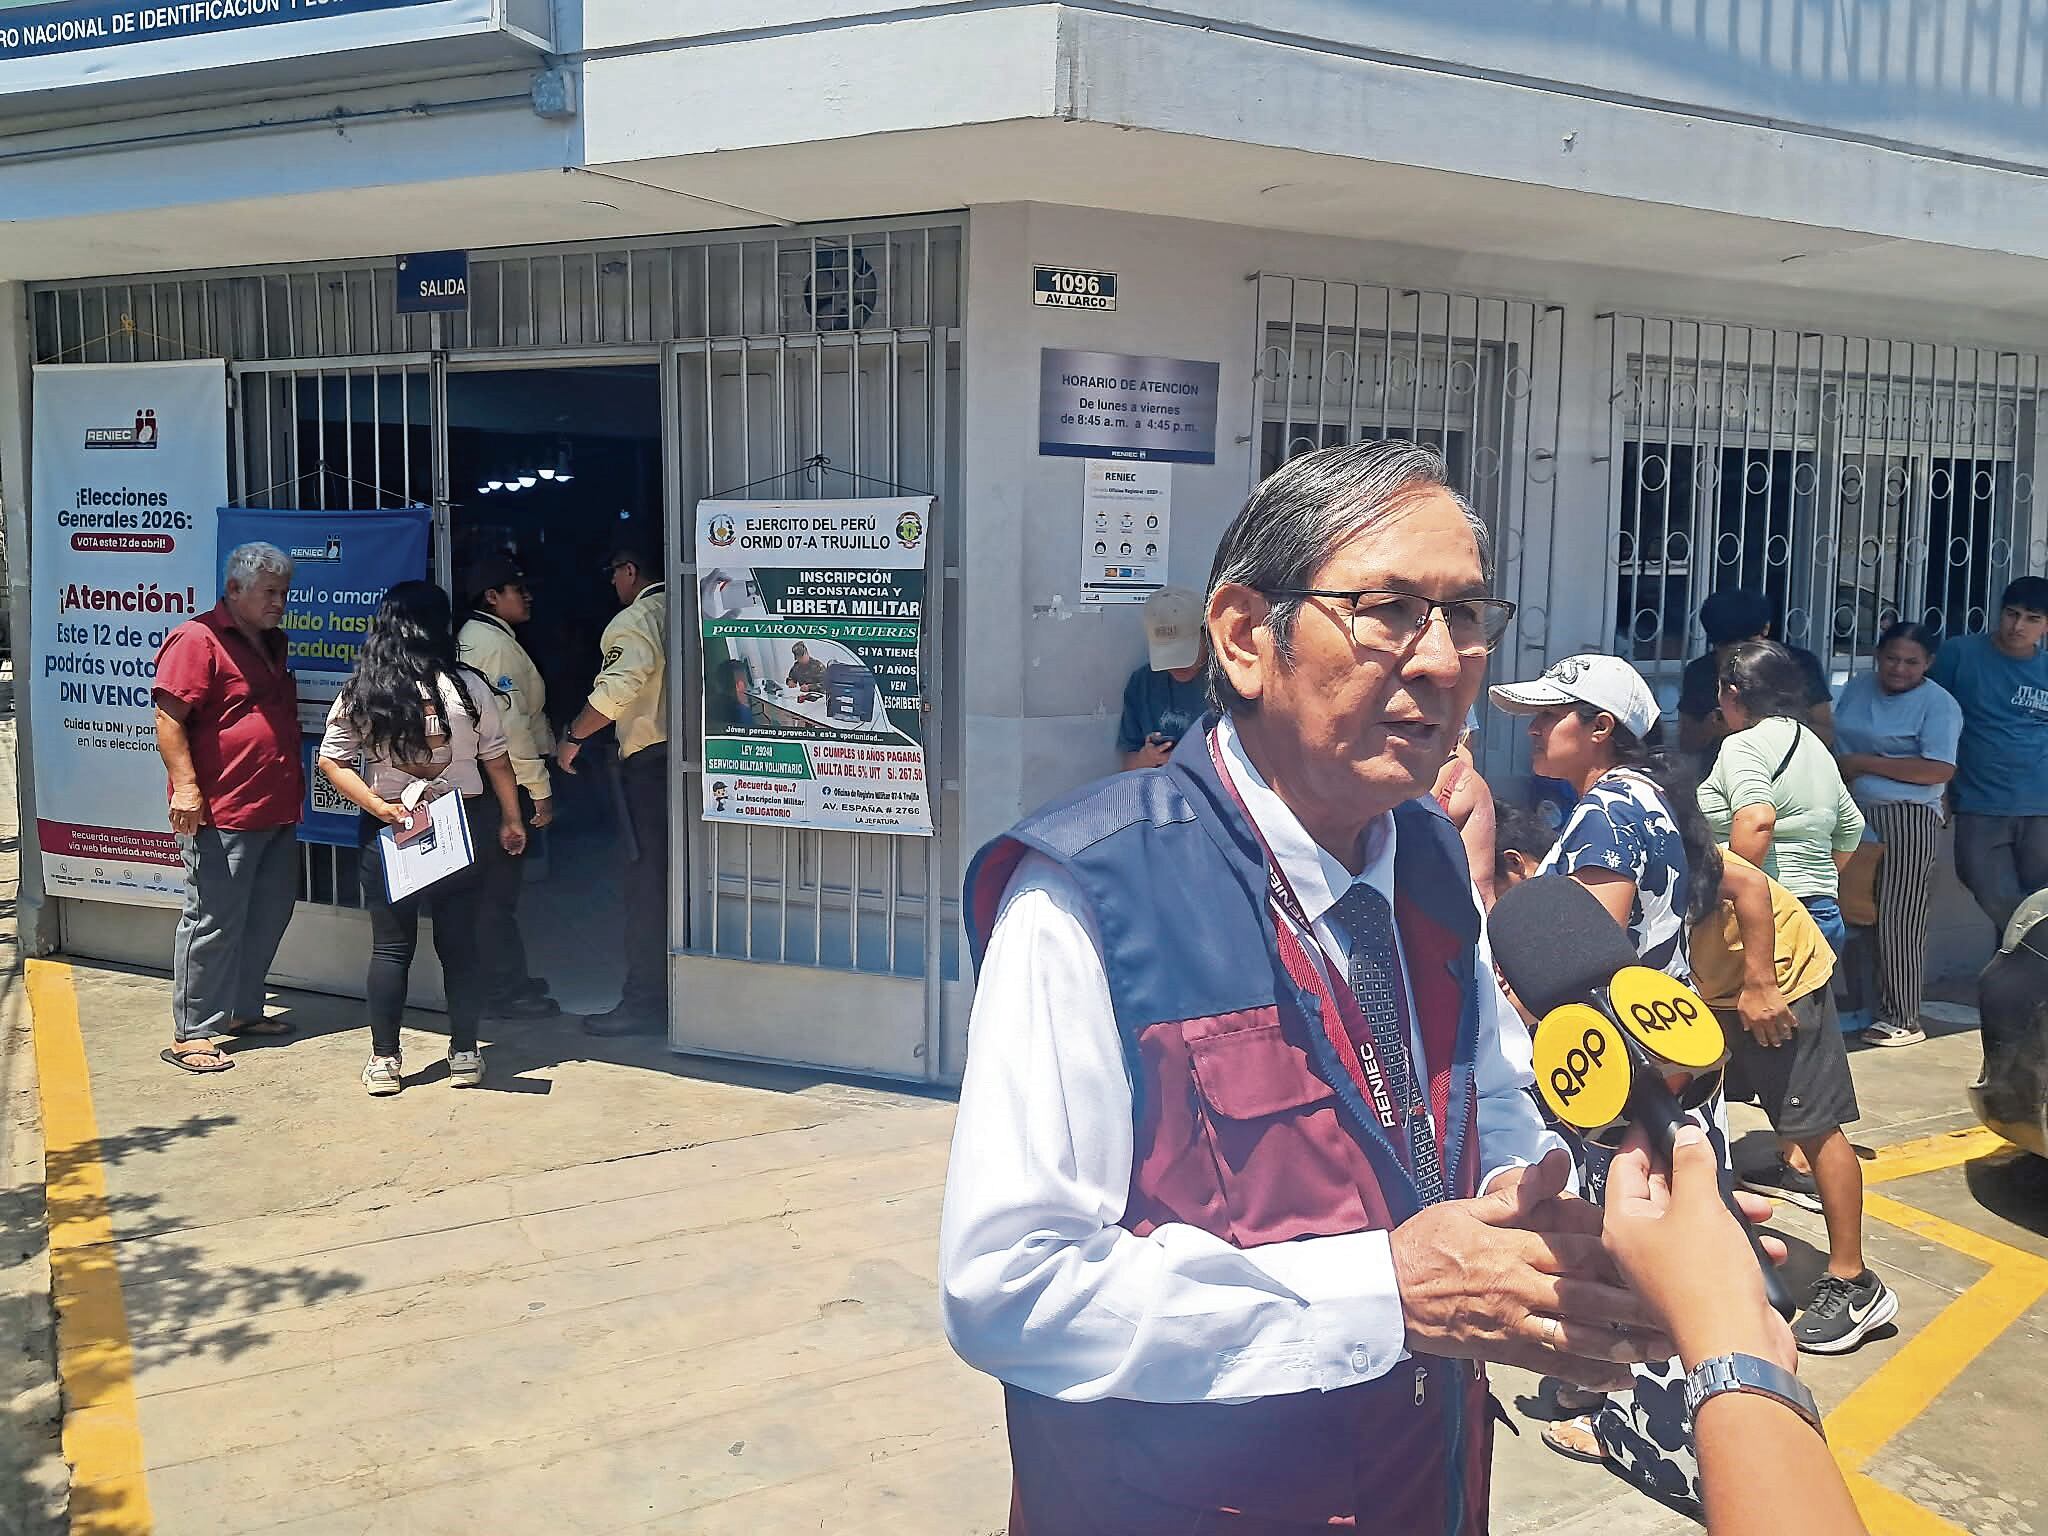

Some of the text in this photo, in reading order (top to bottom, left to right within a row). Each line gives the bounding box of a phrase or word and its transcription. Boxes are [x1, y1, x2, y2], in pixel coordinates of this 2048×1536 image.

[23, 17, 108, 46] NACIONAL
[112, 12, 136, 34] DE
[420, 278, 466, 297] SALIDA
[1051, 272, 1100, 294] 1096
[1046, 293, 1107, 307] AV. LARCO
[1062, 375, 1117, 389] HORARIO
[1120, 379, 1137, 391] DE
[1079, 397, 1180, 415] De lunes a viernes
[1060, 413, 1075, 424] de
[1077, 414, 1101, 426] 8:45
[1134, 420, 1142, 429] a
[1147, 419, 1170, 431] 4:45
[87, 430, 132, 441] RENIEC
[1111, 450, 1139, 458] RENIEC
[1105, 472, 1137, 482] RENIEC
[76, 486, 168, 509] ¡Elecciones
[57, 510, 193, 530] Generales 2026:
[746, 514, 876, 531] EJERCITO DEL PERÚ
[77, 537, 166, 549] VOTA este 12 de abril!
[740, 535, 891, 550] ORMD 07-A TRUJILLO
[290, 548, 324, 557] RENIEC
[800, 569, 892, 584] INSCRIPCIÓN
[59, 583, 196, 614] ¡Atención!
[317, 591, 328, 603] o
[787, 586, 902, 597] DE CONSTANCIA Y
[776, 598, 920, 616] LIBRETA MILITAR
[57, 623, 169, 648] Este 12 de a
[713, 624, 917, 637] para VARONES y MUJERES
[858, 647, 920, 658] SI YA TIENES
[45, 652, 105, 677] podrás
[873, 663, 917, 675] 17 AÑOS
[60, 682, 87, 703] DNI
[890, 680, 907, 691] VEN
[63, 718, 90, 731] Cuida
[92, 720, 103, 732] tu
[105, 722, 124, 733] DNI
[126, 725, 133, 737] y
[749, 727, 776, 736] peruano
[77, 737, 90, 747] en
[92, 736, 107, 748] las
[741, 745, 753, 756] LEY
[813, 746, 921, 763] SI CUMPLES 18 AÑOS PAGARAS
[708, 759, 803, 774] SERVICIO MILITAR VOLUNTARIO
[817, 762, 842, 776] MULTA
[844, 764, 857, 777] DEL
[858, 765, 868, 778] 5%
[869, 766, 881, 779] UIT
[898, 767, 923, 781] 267.50
[733, 779, 797, 793] ¿Recuerda que..?
[736, 793, 745, 801] La
[783, 797, 806, 806] Militar
[744, 806, 791, 818] OBLIGATORIO
[822, 802, 839, 811] AV.
[841, 803, 884, 814] ESPAÑA
[895, 807, 921, 815] 2766
[71, 830, 109, 842] Recuerda
[110, 835, 141, 846] realizar
[141, 838, 155, 847] tus
[81, 844, 99, 853] web
[1630, 997, 1698, 1034] RPP
[1550, 1028, 1606, 1107] RPP
[1360, 1042, 1397, 1128] RENIEC
